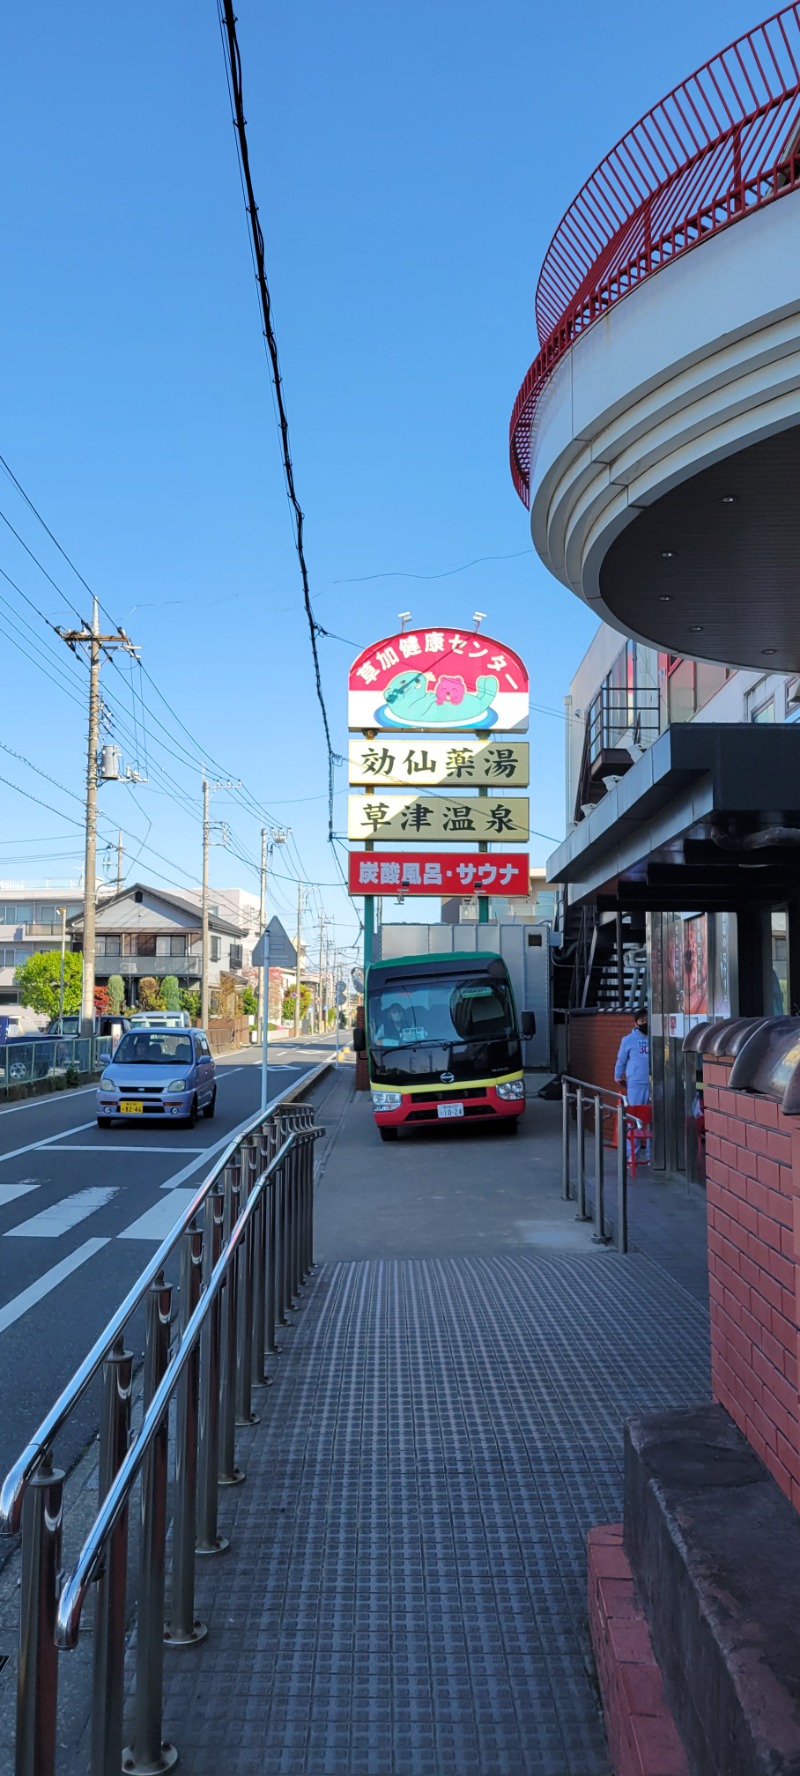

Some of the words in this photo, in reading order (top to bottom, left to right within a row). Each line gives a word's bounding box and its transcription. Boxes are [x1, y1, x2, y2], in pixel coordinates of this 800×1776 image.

[356, 631, 518, 690] 草加健康センター
[360, 747, 518, 779] 効仙薬湯
[360, 802, 518, 833] 草津温泉
[358, 861, 519, 886] 炭酸風呂・サウナ
